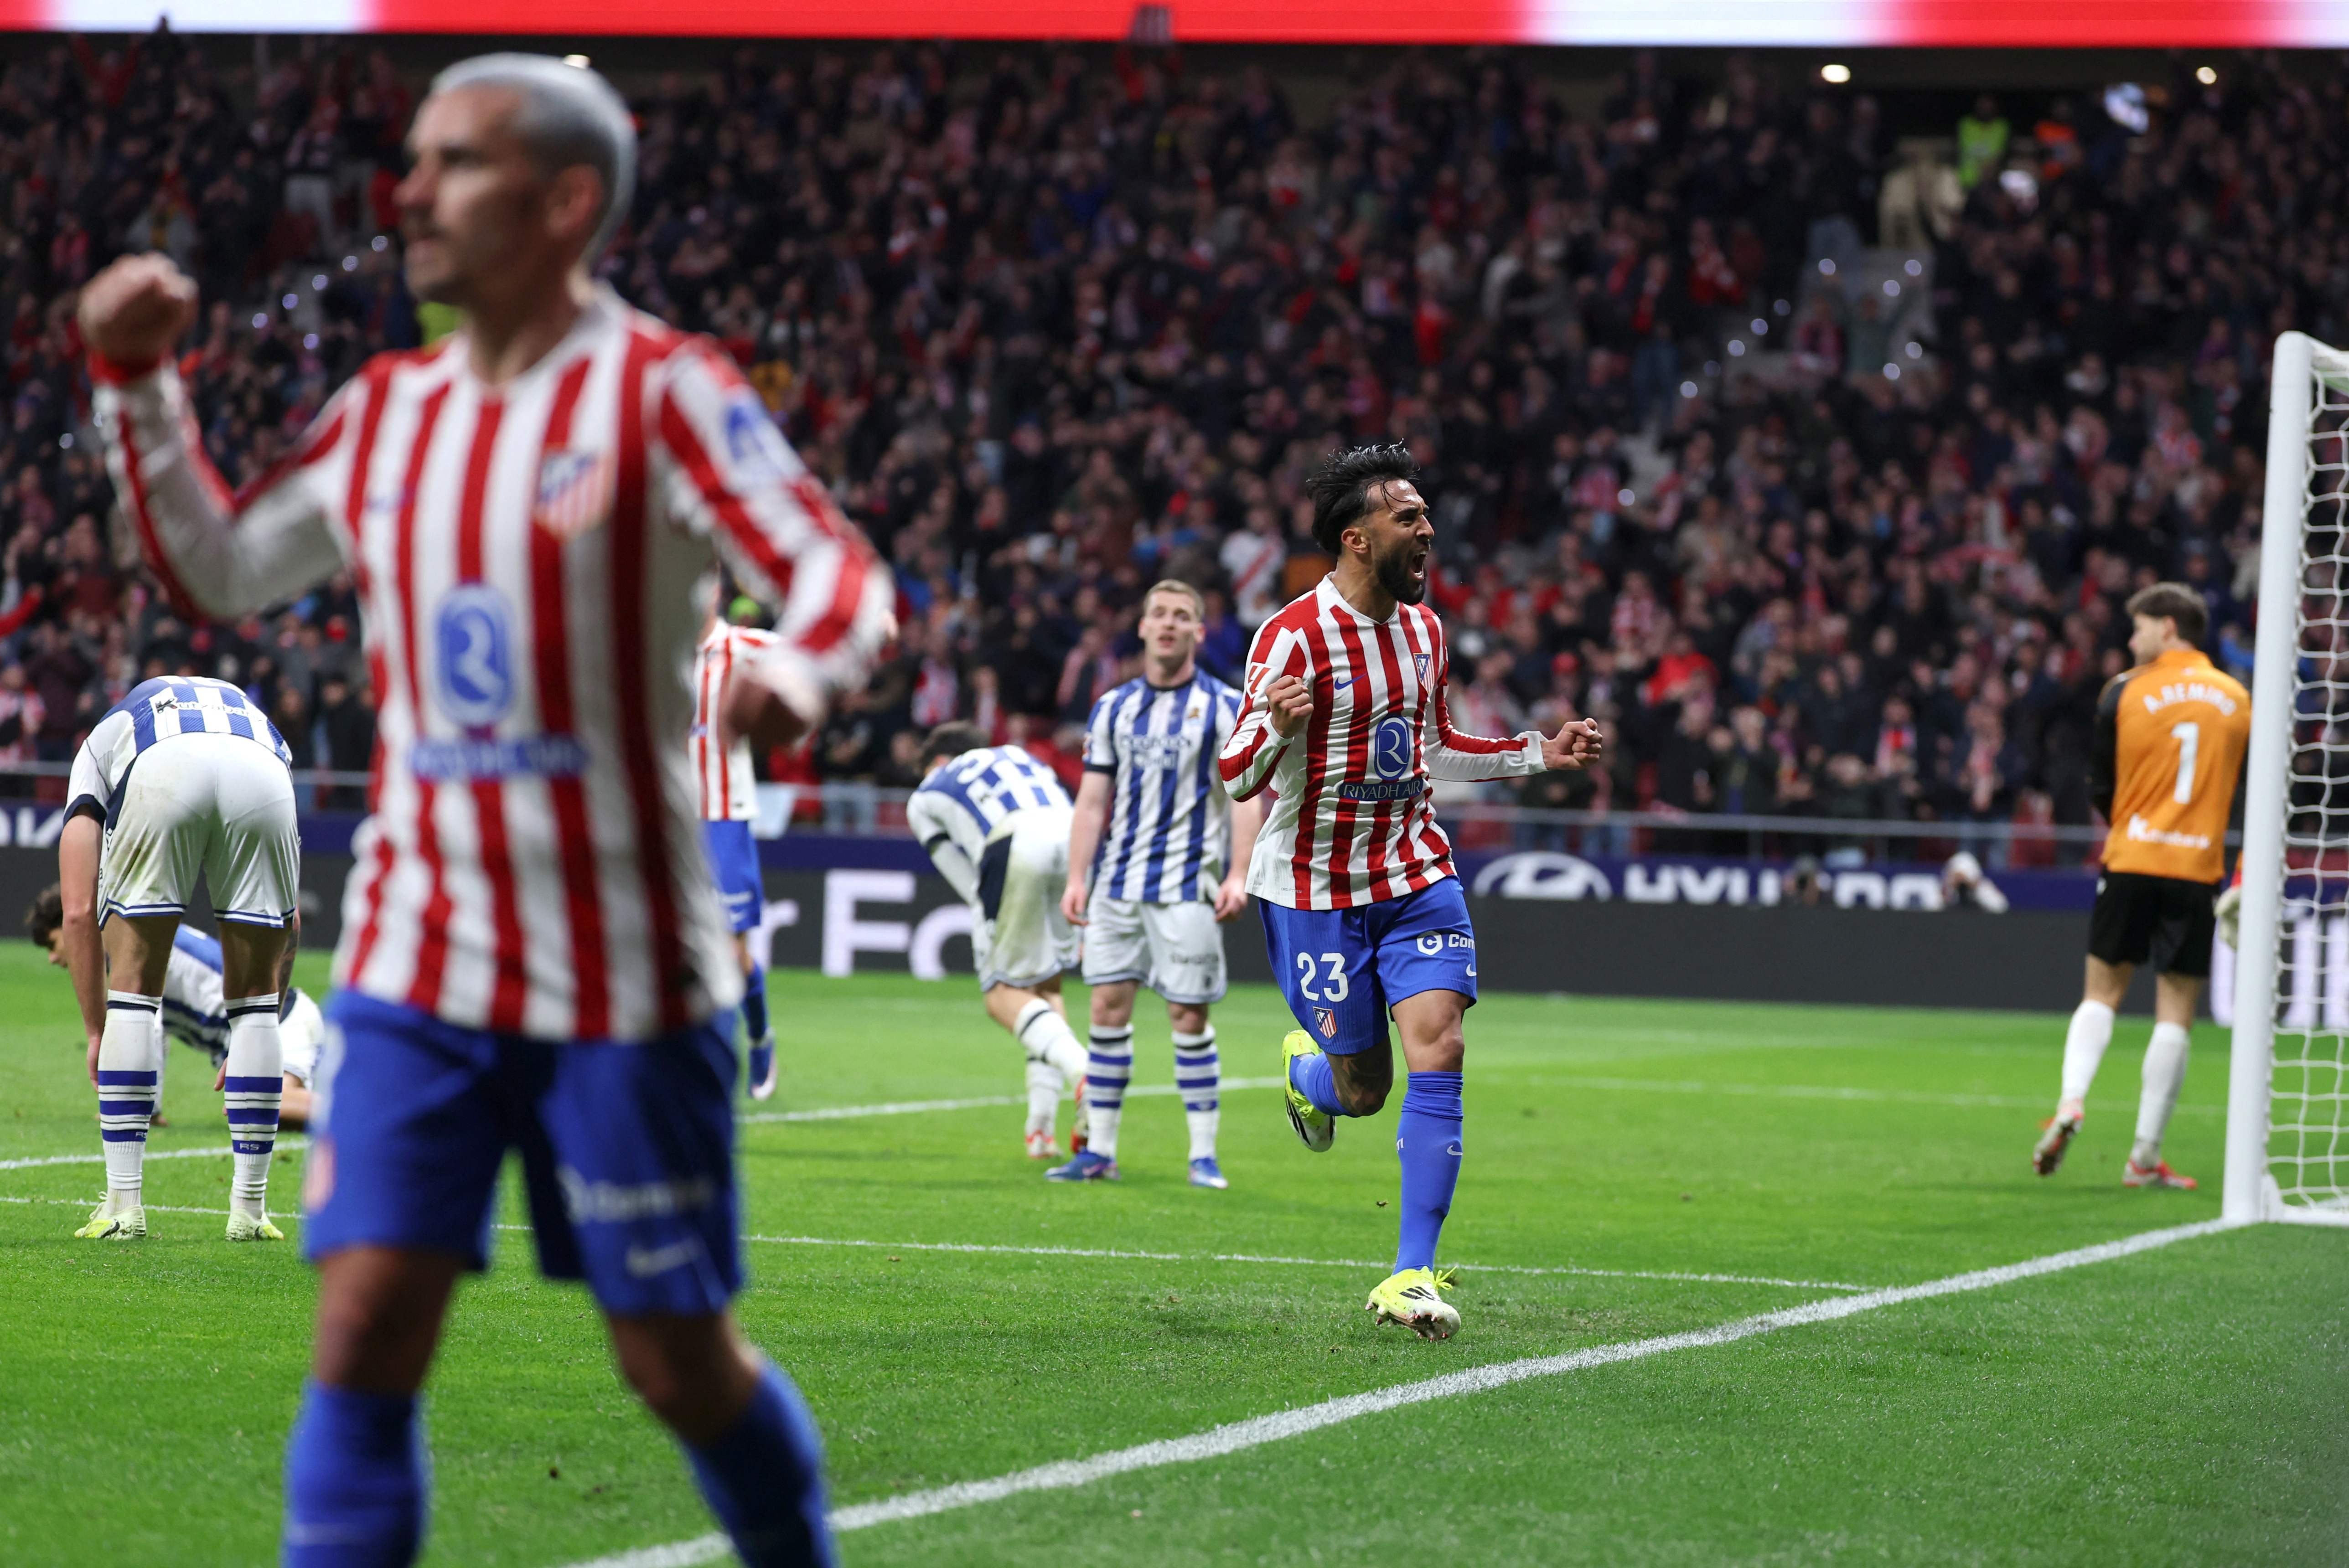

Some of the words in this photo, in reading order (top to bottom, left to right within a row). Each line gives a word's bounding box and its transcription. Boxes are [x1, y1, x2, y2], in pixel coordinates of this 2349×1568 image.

[155, 698, 263, 722] Kutxaba
[2171, 722, 2199, 805] 1
[1343, 784, 1399, 799] RIYADH
[1402, 780, 1420, 796] AIR
[1297, 952, 1348, 1002] 23
[239, 1143, 259, 1151] RS
